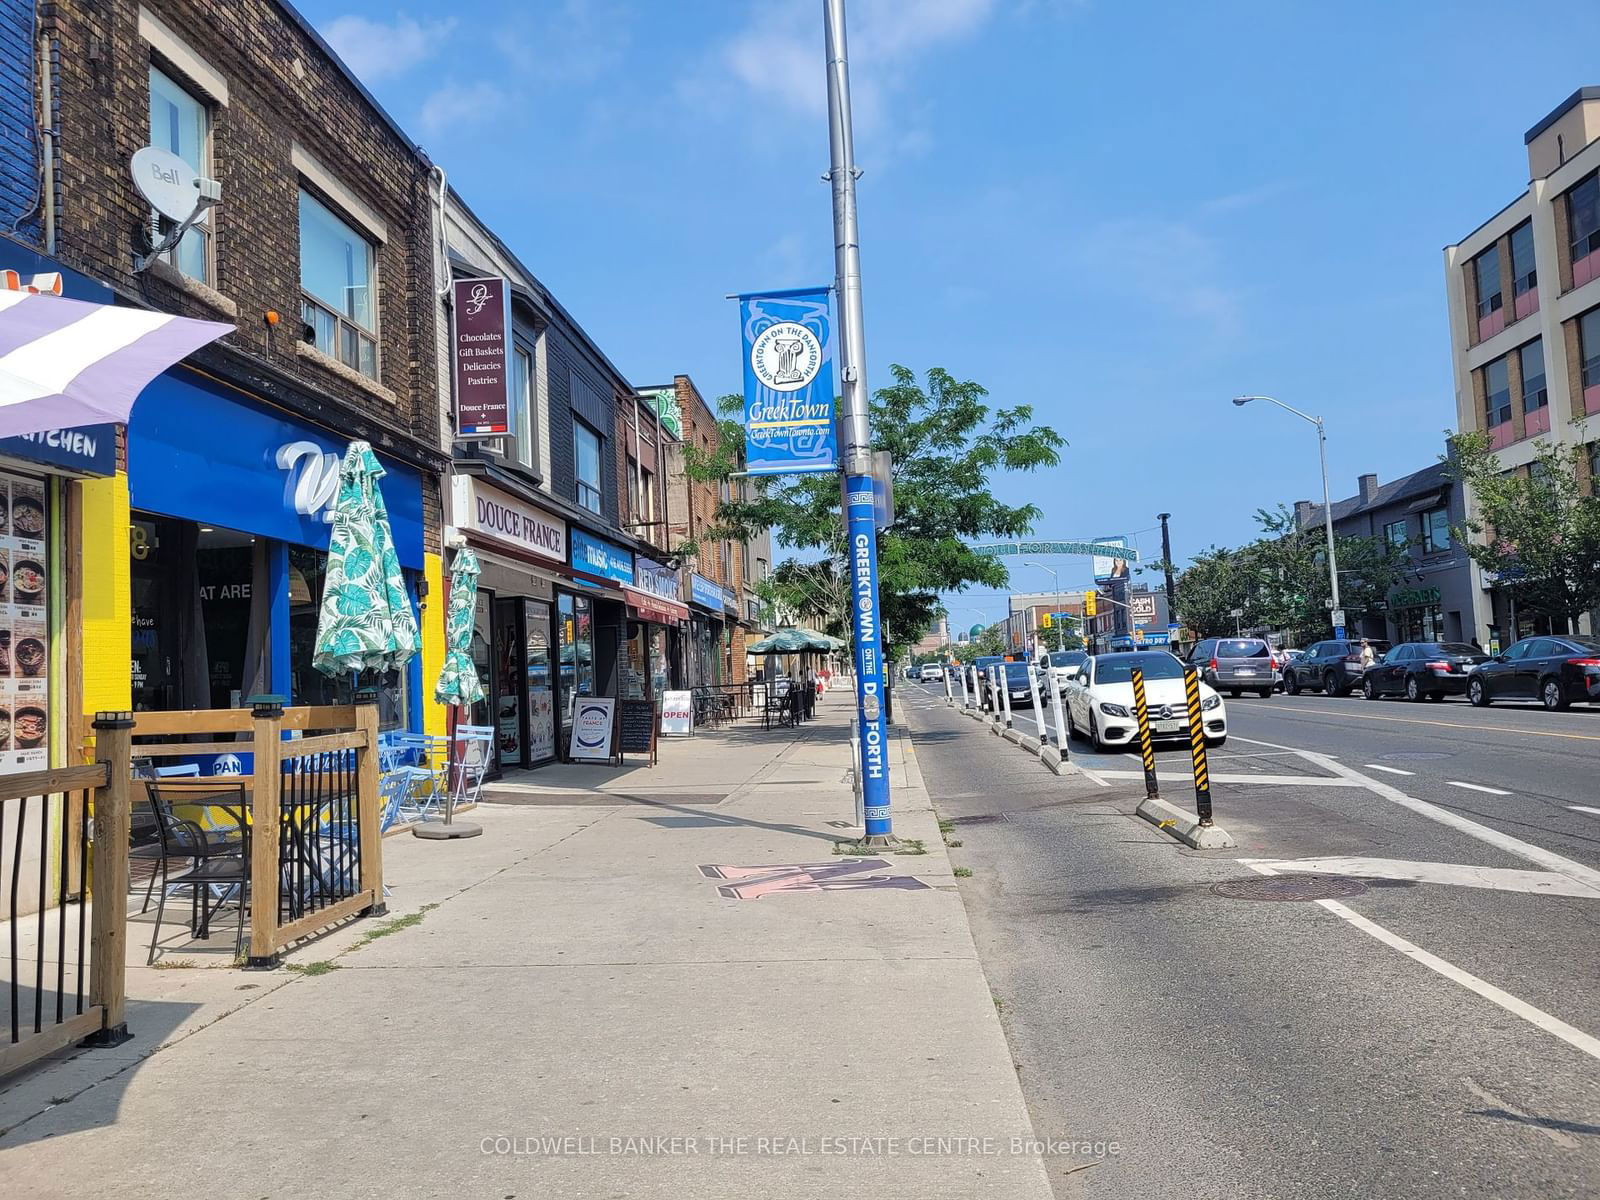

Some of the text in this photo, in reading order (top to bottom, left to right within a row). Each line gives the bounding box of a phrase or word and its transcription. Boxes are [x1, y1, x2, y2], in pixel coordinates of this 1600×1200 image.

[151, 163, 180, 186] Bell
[460, 332, 502, 343] Chocolates
[459, 346, 504, 357] Gift Baskets
[755, 327, 818, 382] GREEKTOWN ON THE DANFORTH
[463, 361, 502, 372] Delicacies
[467, 376, 498, 386] Pastries
[460, 402, 506, 412] Douce France
[17, 429, 97, 458] ITCHEN
[476, 495, 561, 553] DOUCE FRANCE
[200, 583, 251, 600] AT ARE
[855, 534, 875, 642] GREEKTOWN
[864, 648, 872, 660] ON
[865, 661, 873, 675] THE
[663, 711, 689, 719] OPEN
[213, 761, 241, 775] PAN
